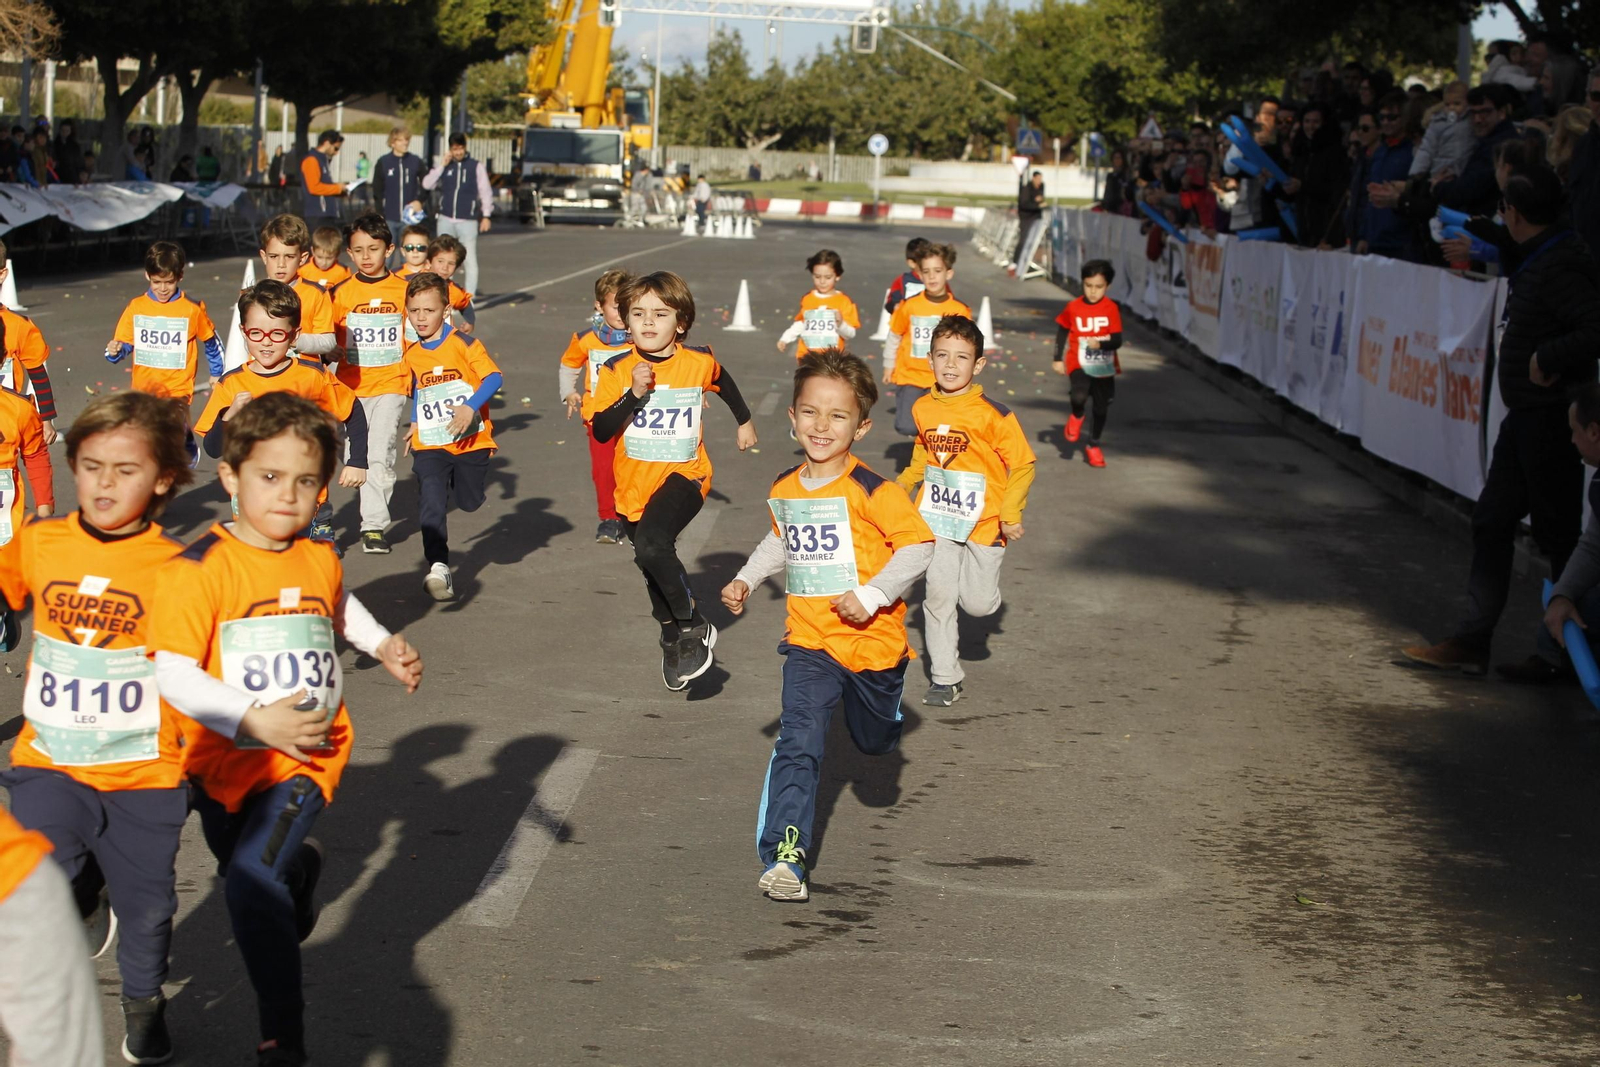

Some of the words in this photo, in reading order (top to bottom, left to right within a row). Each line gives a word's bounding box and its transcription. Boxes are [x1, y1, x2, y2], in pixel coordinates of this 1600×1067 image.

[1075, 316, 1109, 334] UP
[140, 329, 182, 346] 8504
[353, 327, 397, 343] 8318
[425, 374, 456, 384] SUPER
[632, 407, 693, 429] 8271
[928, 435, 962, 445] SUPER
[930, 484, 977, 511] 8444
[810, 511, 840, 519] INFANTIL
[931, 503, 946, 512] DAVID
[54, 593, 130, 617] SUPER
[48, 608, 138, 635] RUNNER
[243, 650, 335, 692] 8032
[40, 671, 144, 714] 8110
[75, 715, 97, 724] LEO
